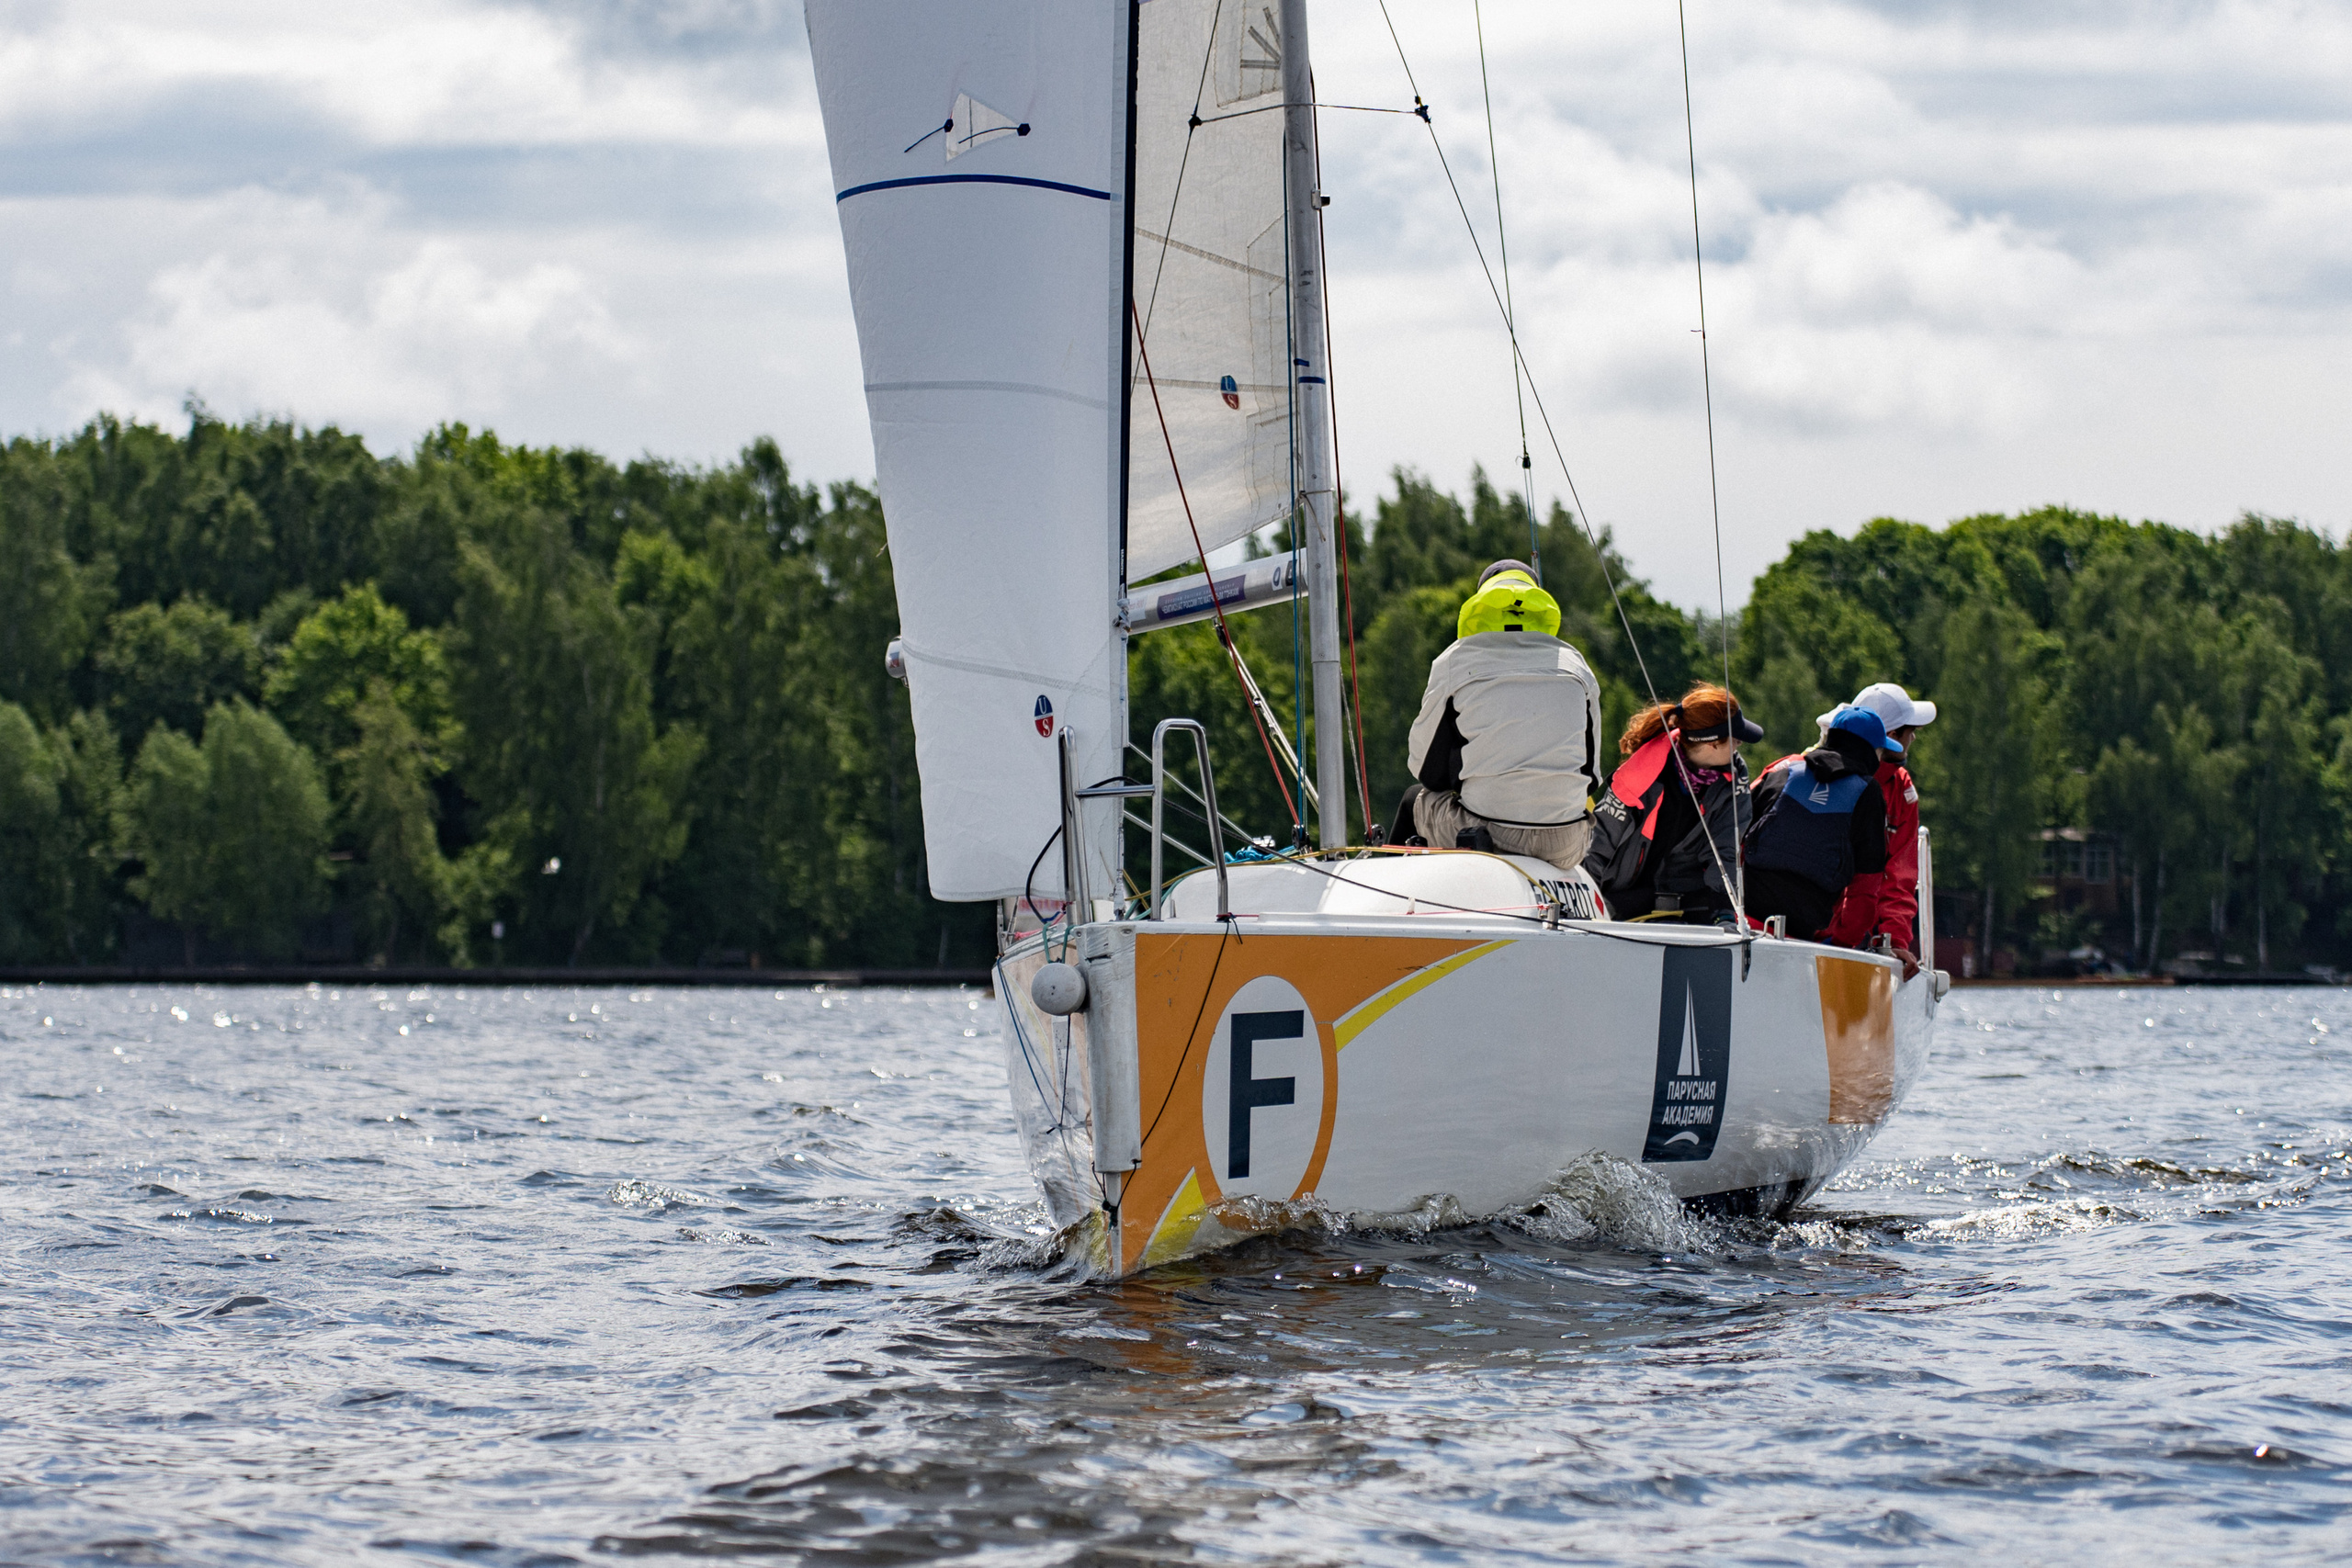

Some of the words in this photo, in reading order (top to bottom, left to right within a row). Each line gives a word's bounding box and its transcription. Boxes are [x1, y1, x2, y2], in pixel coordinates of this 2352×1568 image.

[1038, 697, 1047, 715] U
[1042, 718, 1051, 737] S
[1227, 1010, 1305, 1179] F
[1667, 1080, 1717, 1100] ПАРУСНАЯ
[1661, 1105, 1714, 1126] АКАДЕМИЯ
